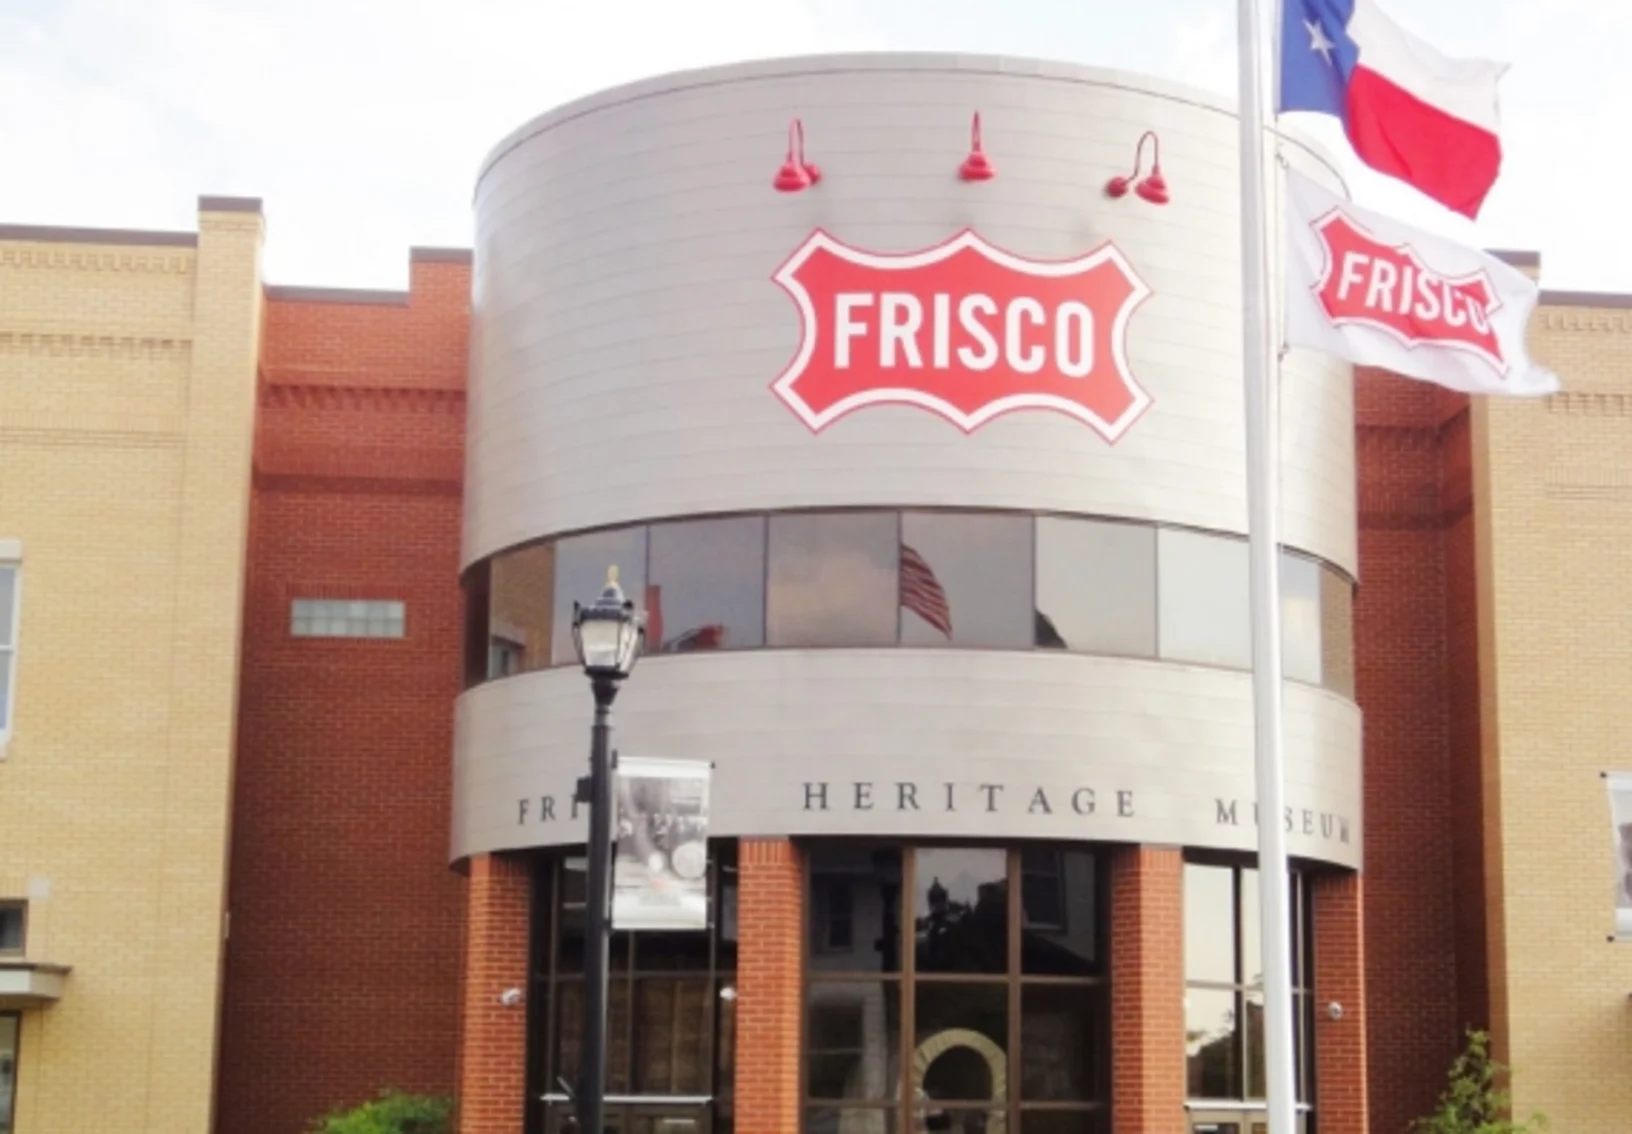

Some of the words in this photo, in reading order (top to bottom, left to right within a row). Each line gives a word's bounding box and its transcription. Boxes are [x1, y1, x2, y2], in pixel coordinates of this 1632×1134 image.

[833, 291, 1096, 378] FRISCO
[1335, 251, 1491, 336] FRISCO
[802, 781, 1136, 818] HERITAGE
